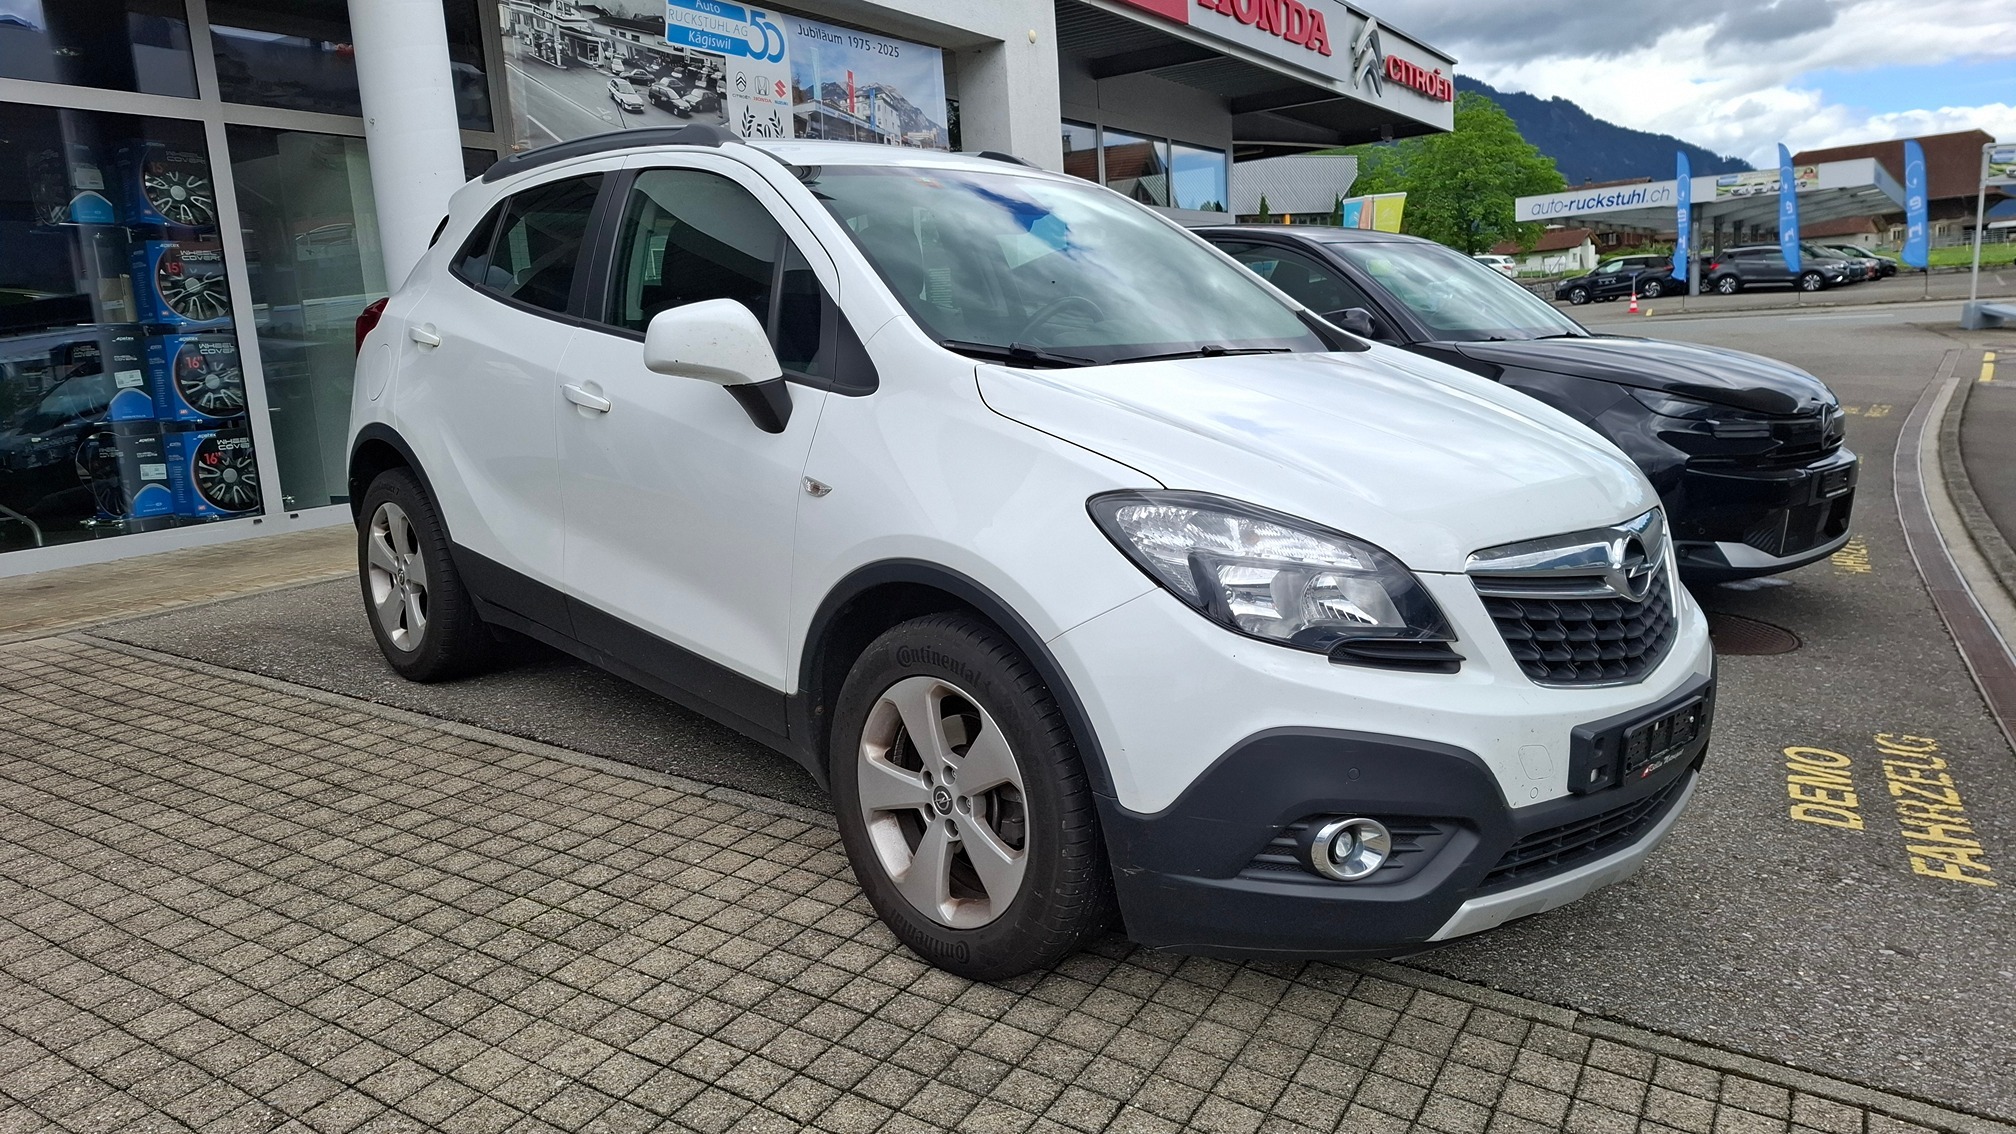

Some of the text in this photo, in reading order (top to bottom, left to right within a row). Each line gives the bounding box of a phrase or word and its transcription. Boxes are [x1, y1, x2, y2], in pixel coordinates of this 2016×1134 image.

[668, 8, 749, 37] RUCKSTUHL AG
[695, 0, 721, 14] Auto
[688, 30, 731, 50] Kägiswil
[797, 24, 843, 45] Jubiläum
[847, 35, 870, 51] 1975
[877, 42, 900, 58] 2025
[1385, 54, 1452, 103] CITROËN
[1531, 183, 1671, 216] auto-ruckstuhl.ch
[896, 645, 982, 689] Continental
[1781, 745, 1866, 831] DEMO
[1873, 732, 1999, 887] FAHRZEUG
